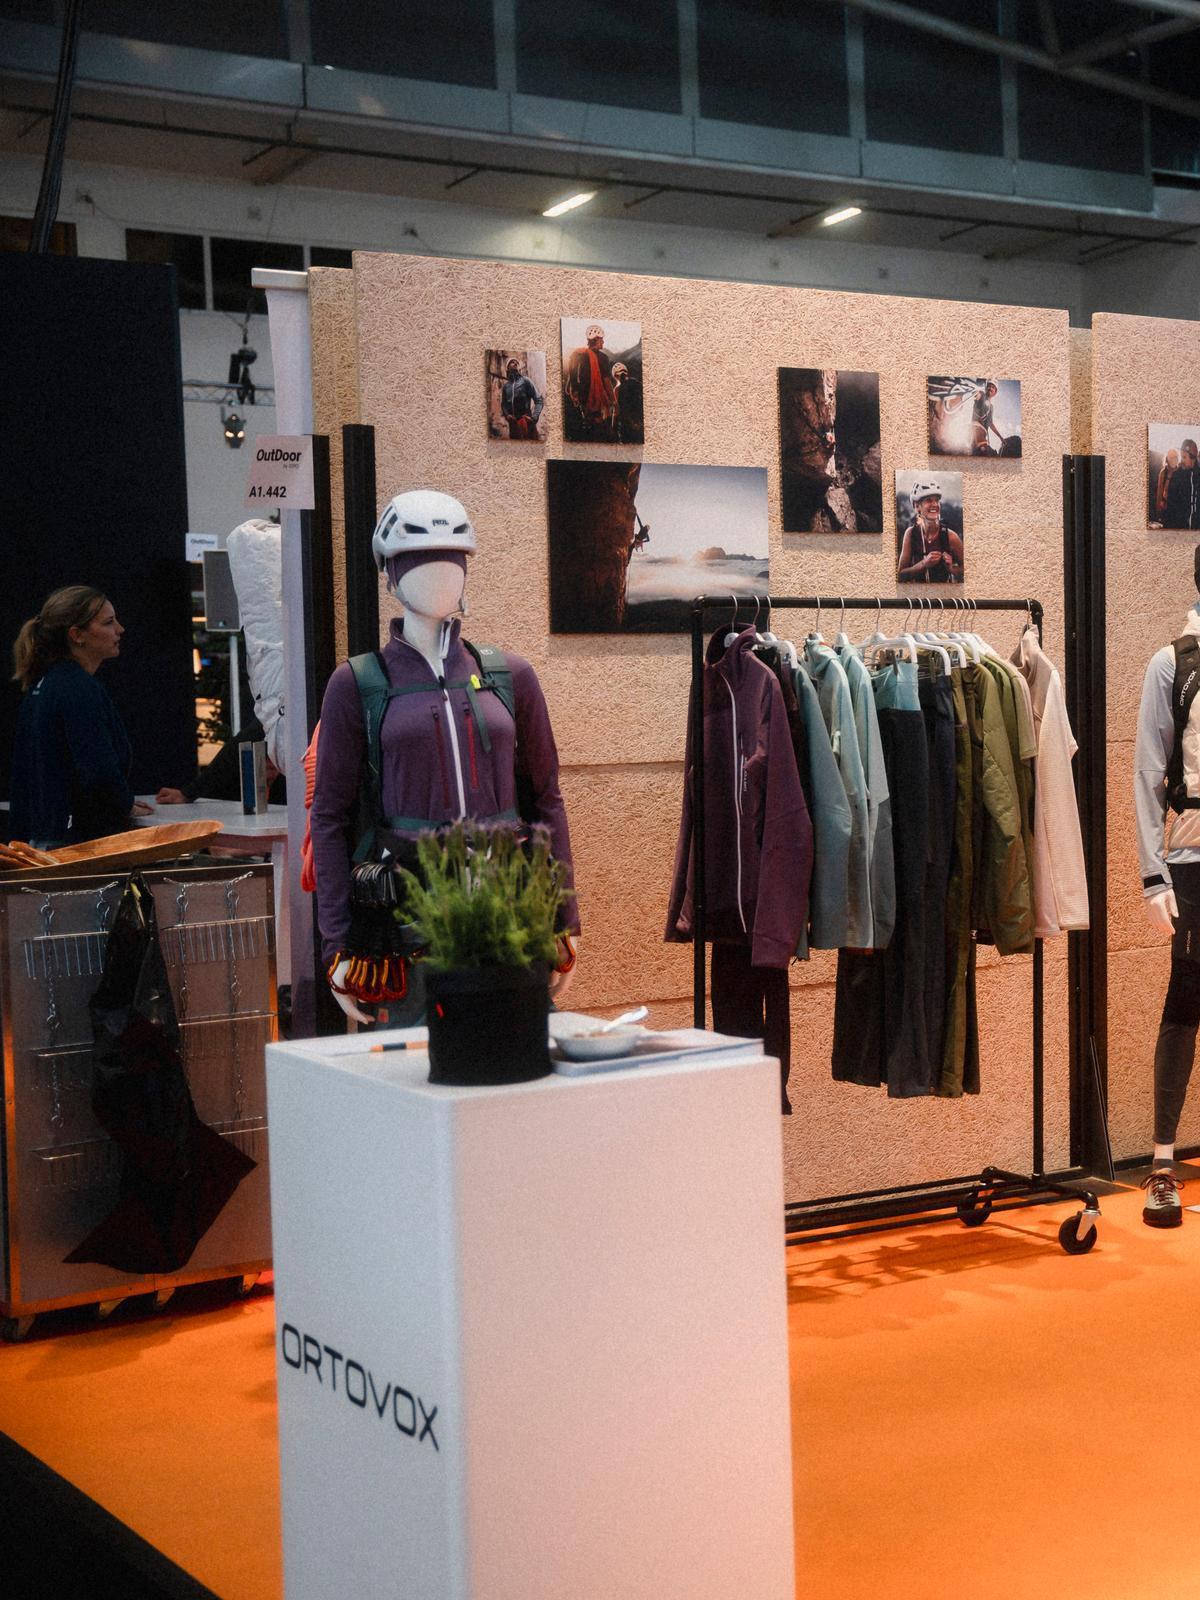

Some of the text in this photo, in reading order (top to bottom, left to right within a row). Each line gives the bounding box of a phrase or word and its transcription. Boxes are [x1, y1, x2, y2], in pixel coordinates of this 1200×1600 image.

[256, 448, 302, 462] OutDoor
[249, 486, 287, 498] A1.442
[1180, 670, 1197, 706] ORTOVOX
[282, 1322, 440, 1452] ORTOVOX
